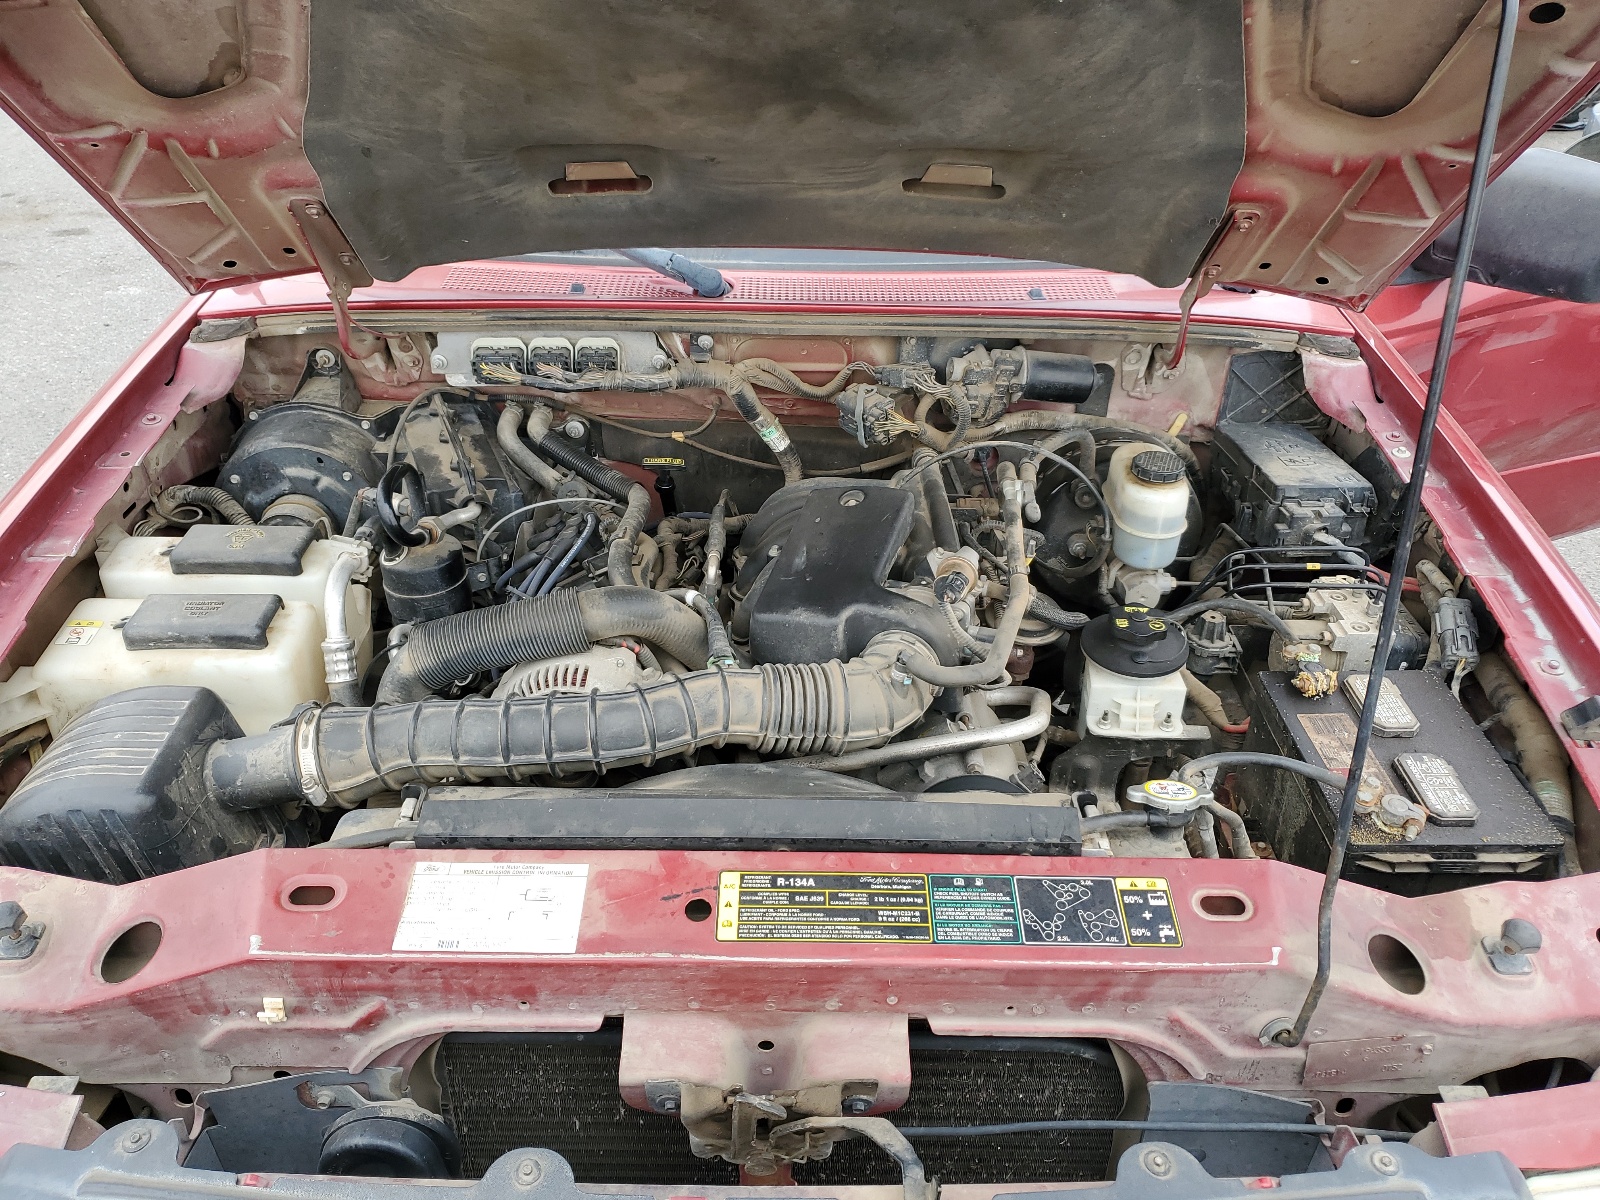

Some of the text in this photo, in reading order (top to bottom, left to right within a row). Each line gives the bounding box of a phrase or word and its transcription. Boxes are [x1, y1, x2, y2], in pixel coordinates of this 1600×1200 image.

[777, 877, 815, 887] R-134A
[1123, 895, 1143, 904] 50%
[1131, 928, 1151, 937] 50%
